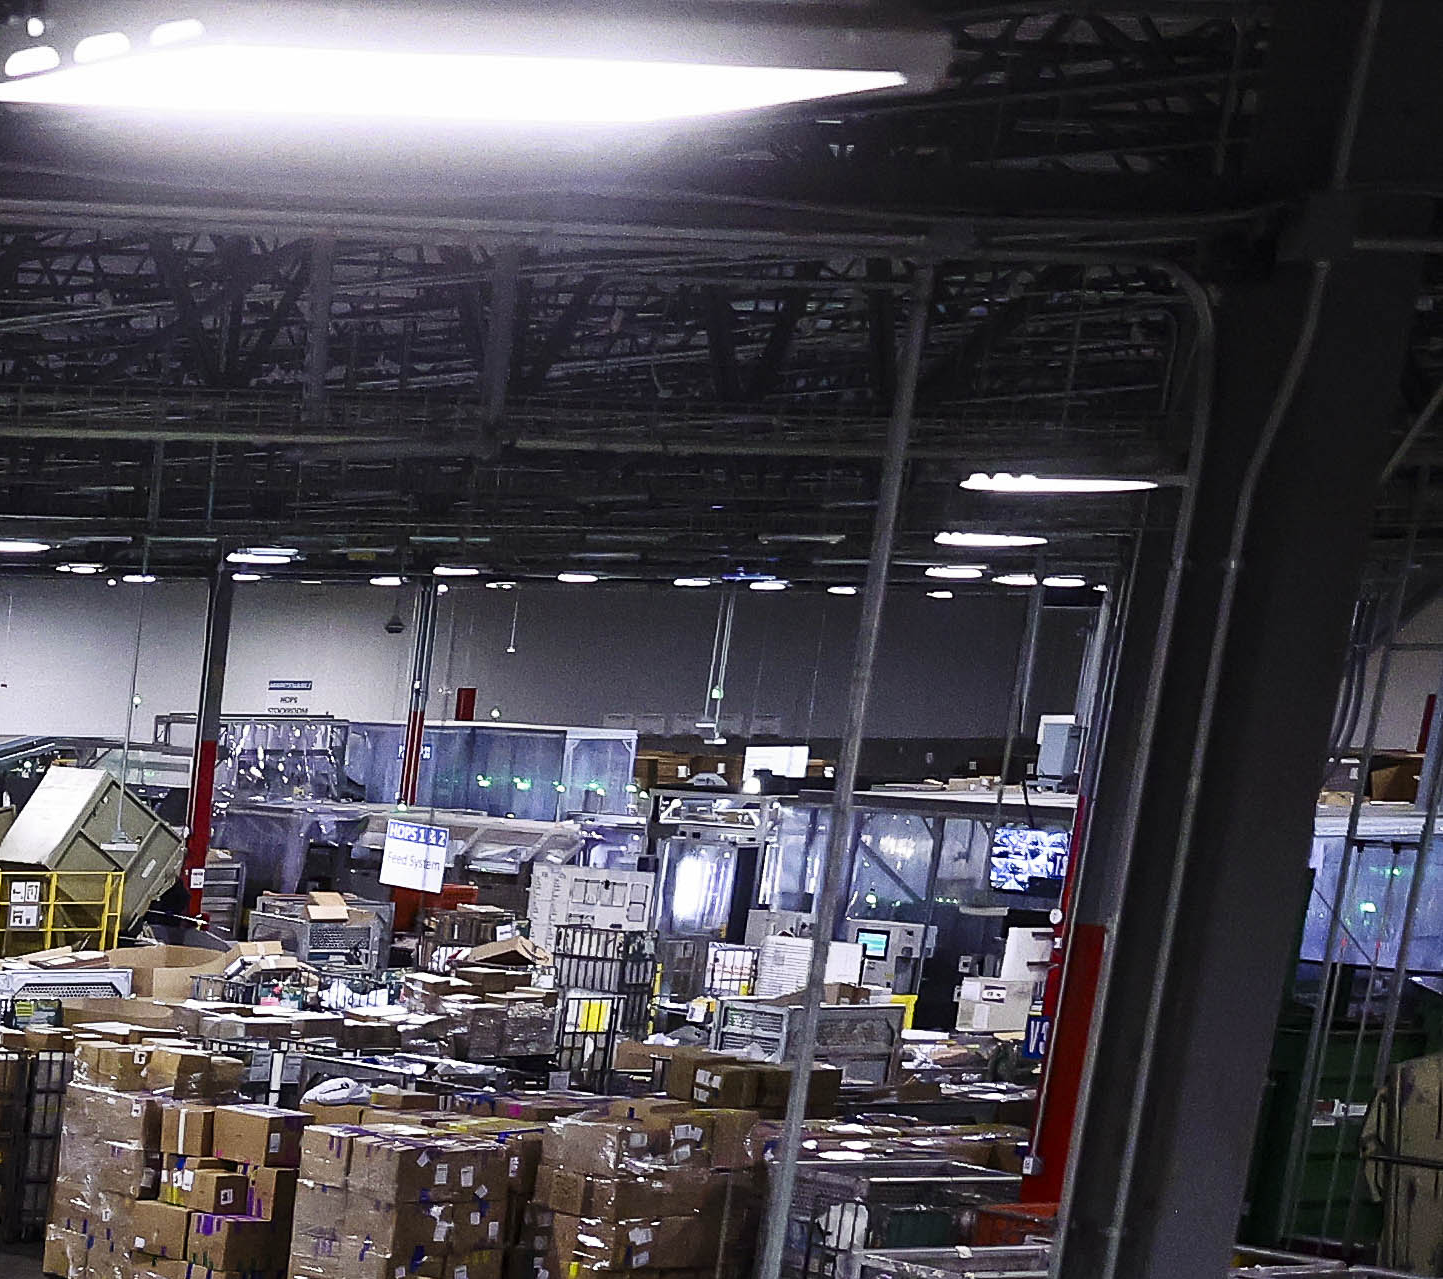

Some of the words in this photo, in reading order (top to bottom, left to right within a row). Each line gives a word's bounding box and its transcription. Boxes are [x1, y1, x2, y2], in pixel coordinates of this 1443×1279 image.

[389, 822, 417, 841] HOPS
[418, 827, 425, 840] 1
[437, 831, 446, 846] 2
[388, 851, 407, 865] Feed
[409, 855, 440, 871] System
